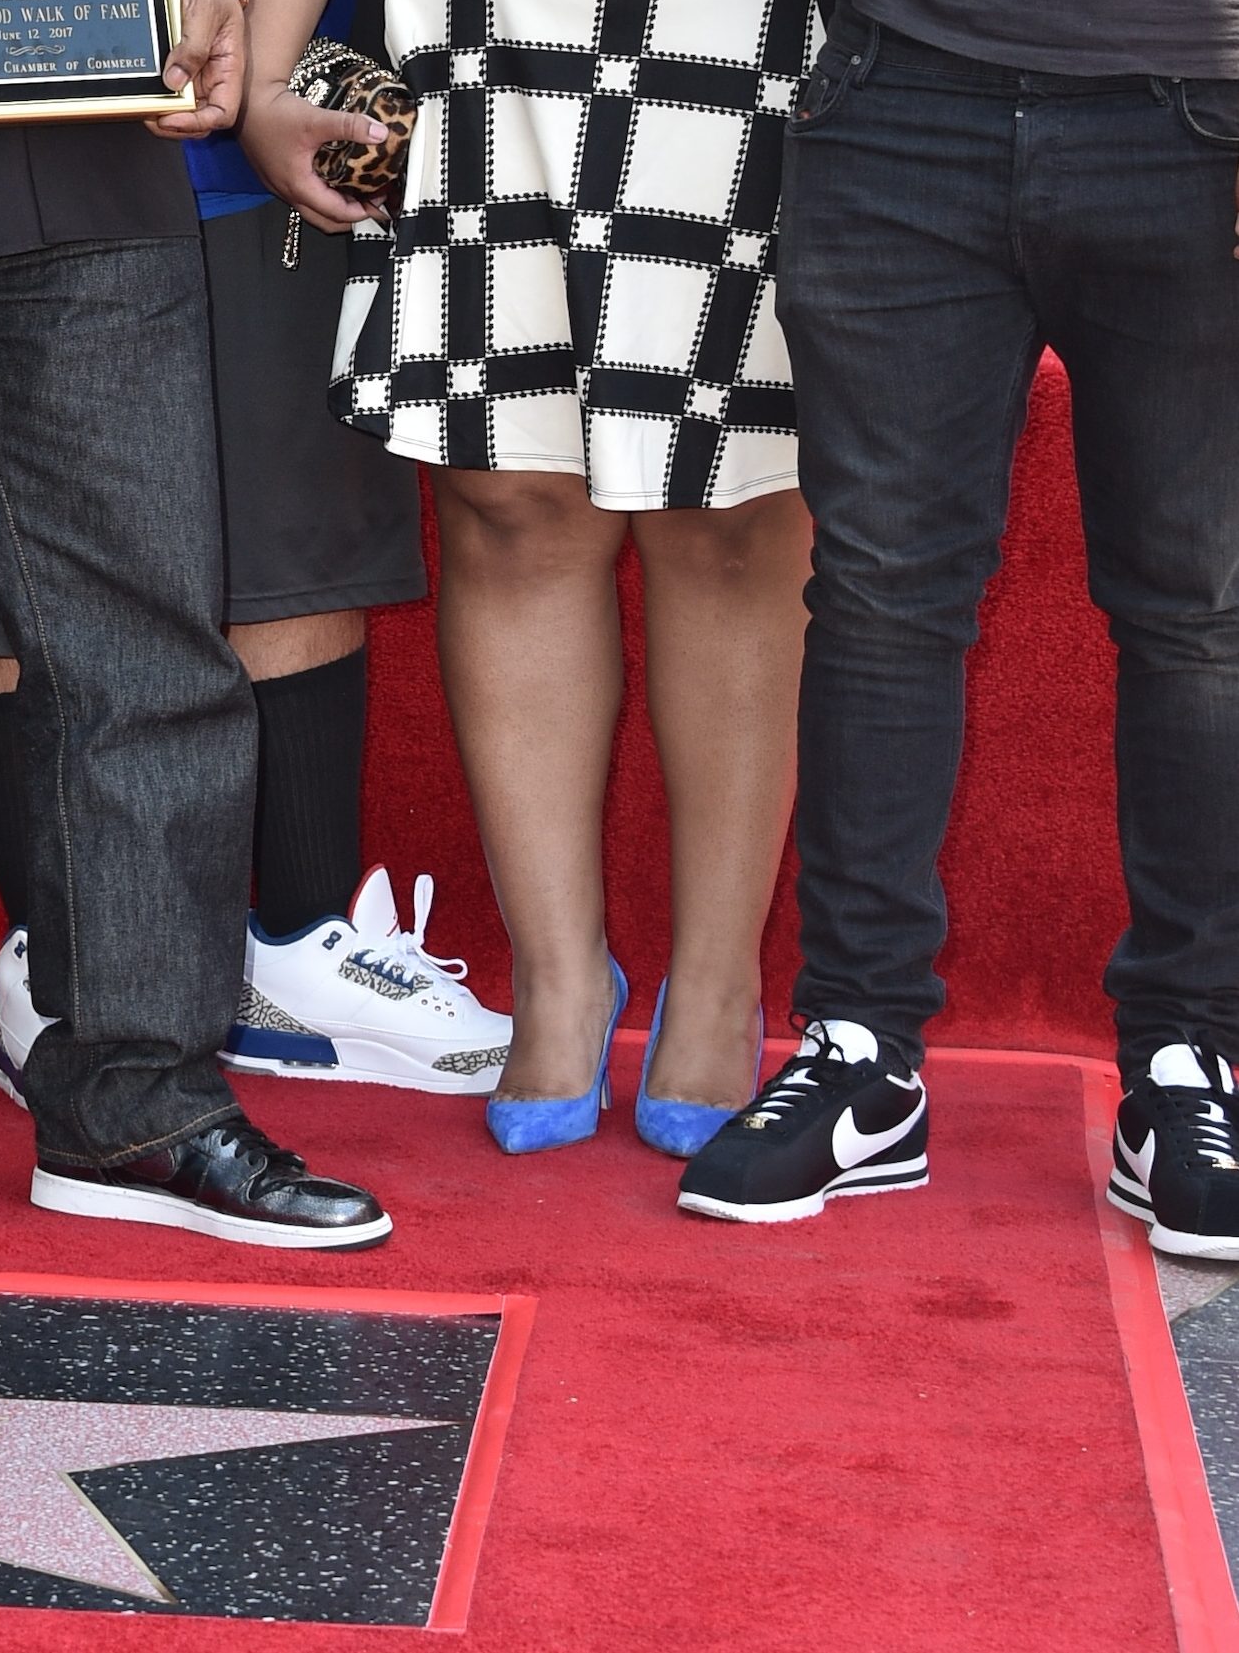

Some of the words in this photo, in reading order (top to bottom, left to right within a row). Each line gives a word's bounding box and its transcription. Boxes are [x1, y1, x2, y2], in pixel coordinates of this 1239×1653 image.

[20, 5, 65, 23] WALK
[73, 4, 91, 21] OF
[101, 2, 140, 20] FAME
[28, 28, 40, 40] 12
[49, 26, 73, 38] 2017
[3, 60, 57, 74] CHAMBER
[87, 57, 146, 70] COMMERCE
